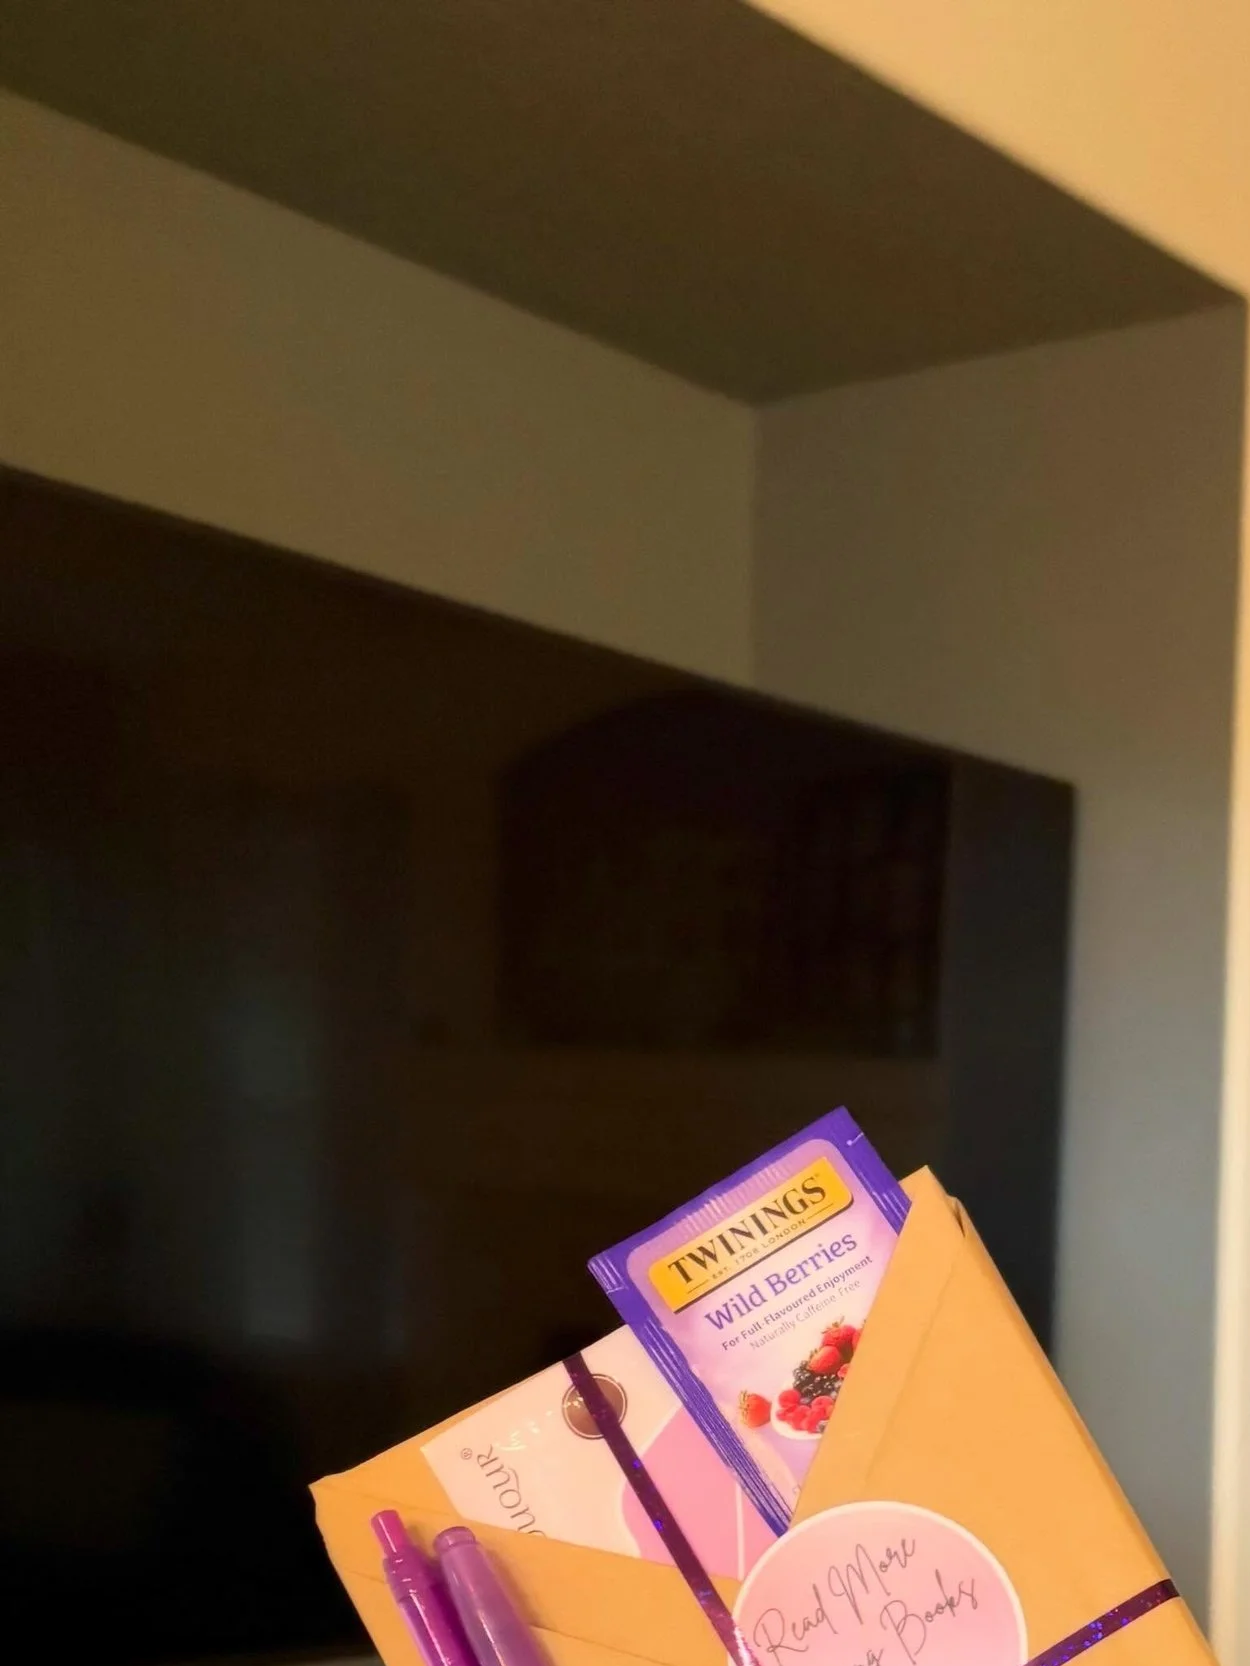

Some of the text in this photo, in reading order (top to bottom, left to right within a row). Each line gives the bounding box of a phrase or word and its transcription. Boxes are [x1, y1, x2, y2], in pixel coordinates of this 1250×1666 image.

[668, 1176, 828, 1285] TWININGS
[762, 1218, 807, 1248] LONDON
[704, 1233, 858, 1331] Wild Berries
[721, 1255, 873, 1351] For Full-Flavoured Enjoyment
[749, 1279, 861, 1351] Naturally Caffeine Free
[828, 1538, 916, 1627] More
[879, 1568, 979, 1666] Books
